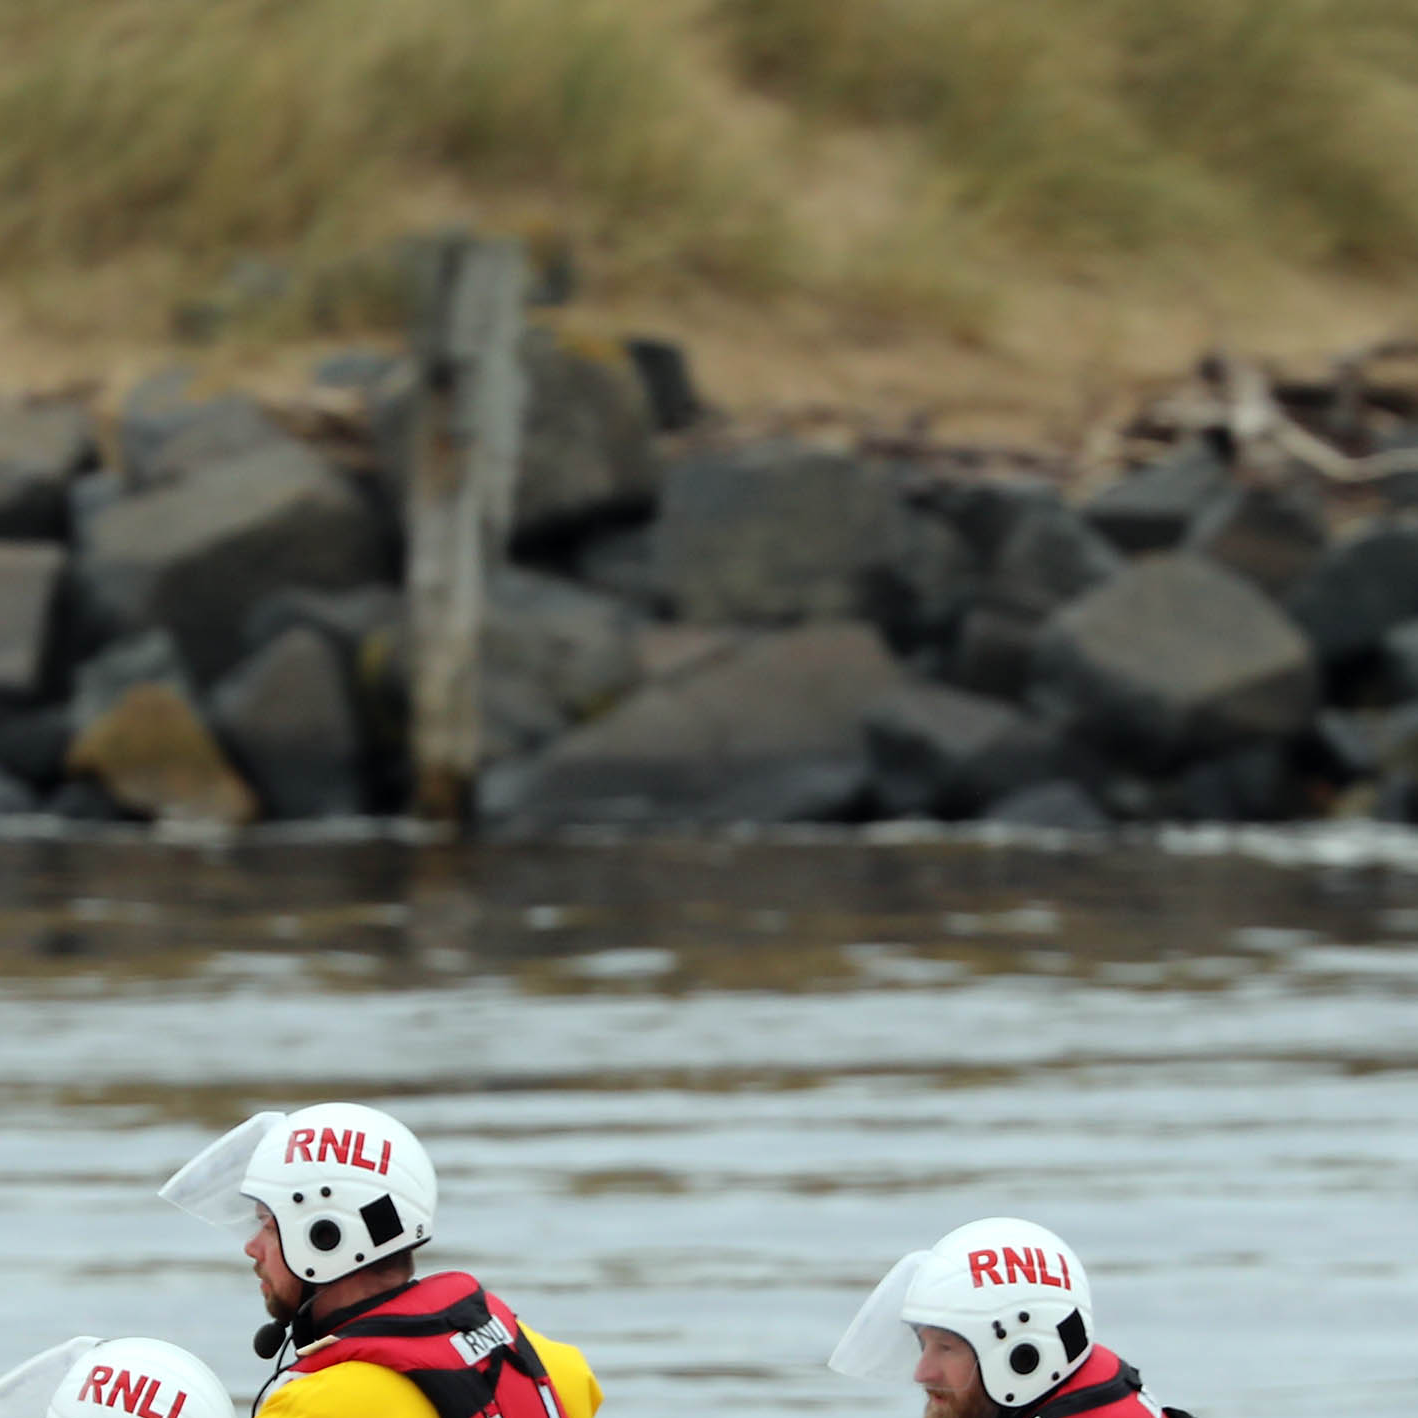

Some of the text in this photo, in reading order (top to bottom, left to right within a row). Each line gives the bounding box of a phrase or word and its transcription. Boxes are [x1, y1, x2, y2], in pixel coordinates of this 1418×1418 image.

[284, 1126, 392, 1176] RNLI
[416, 1224, 424, 1239] 8
[967, 1246, 1072, 1291] RNLI
